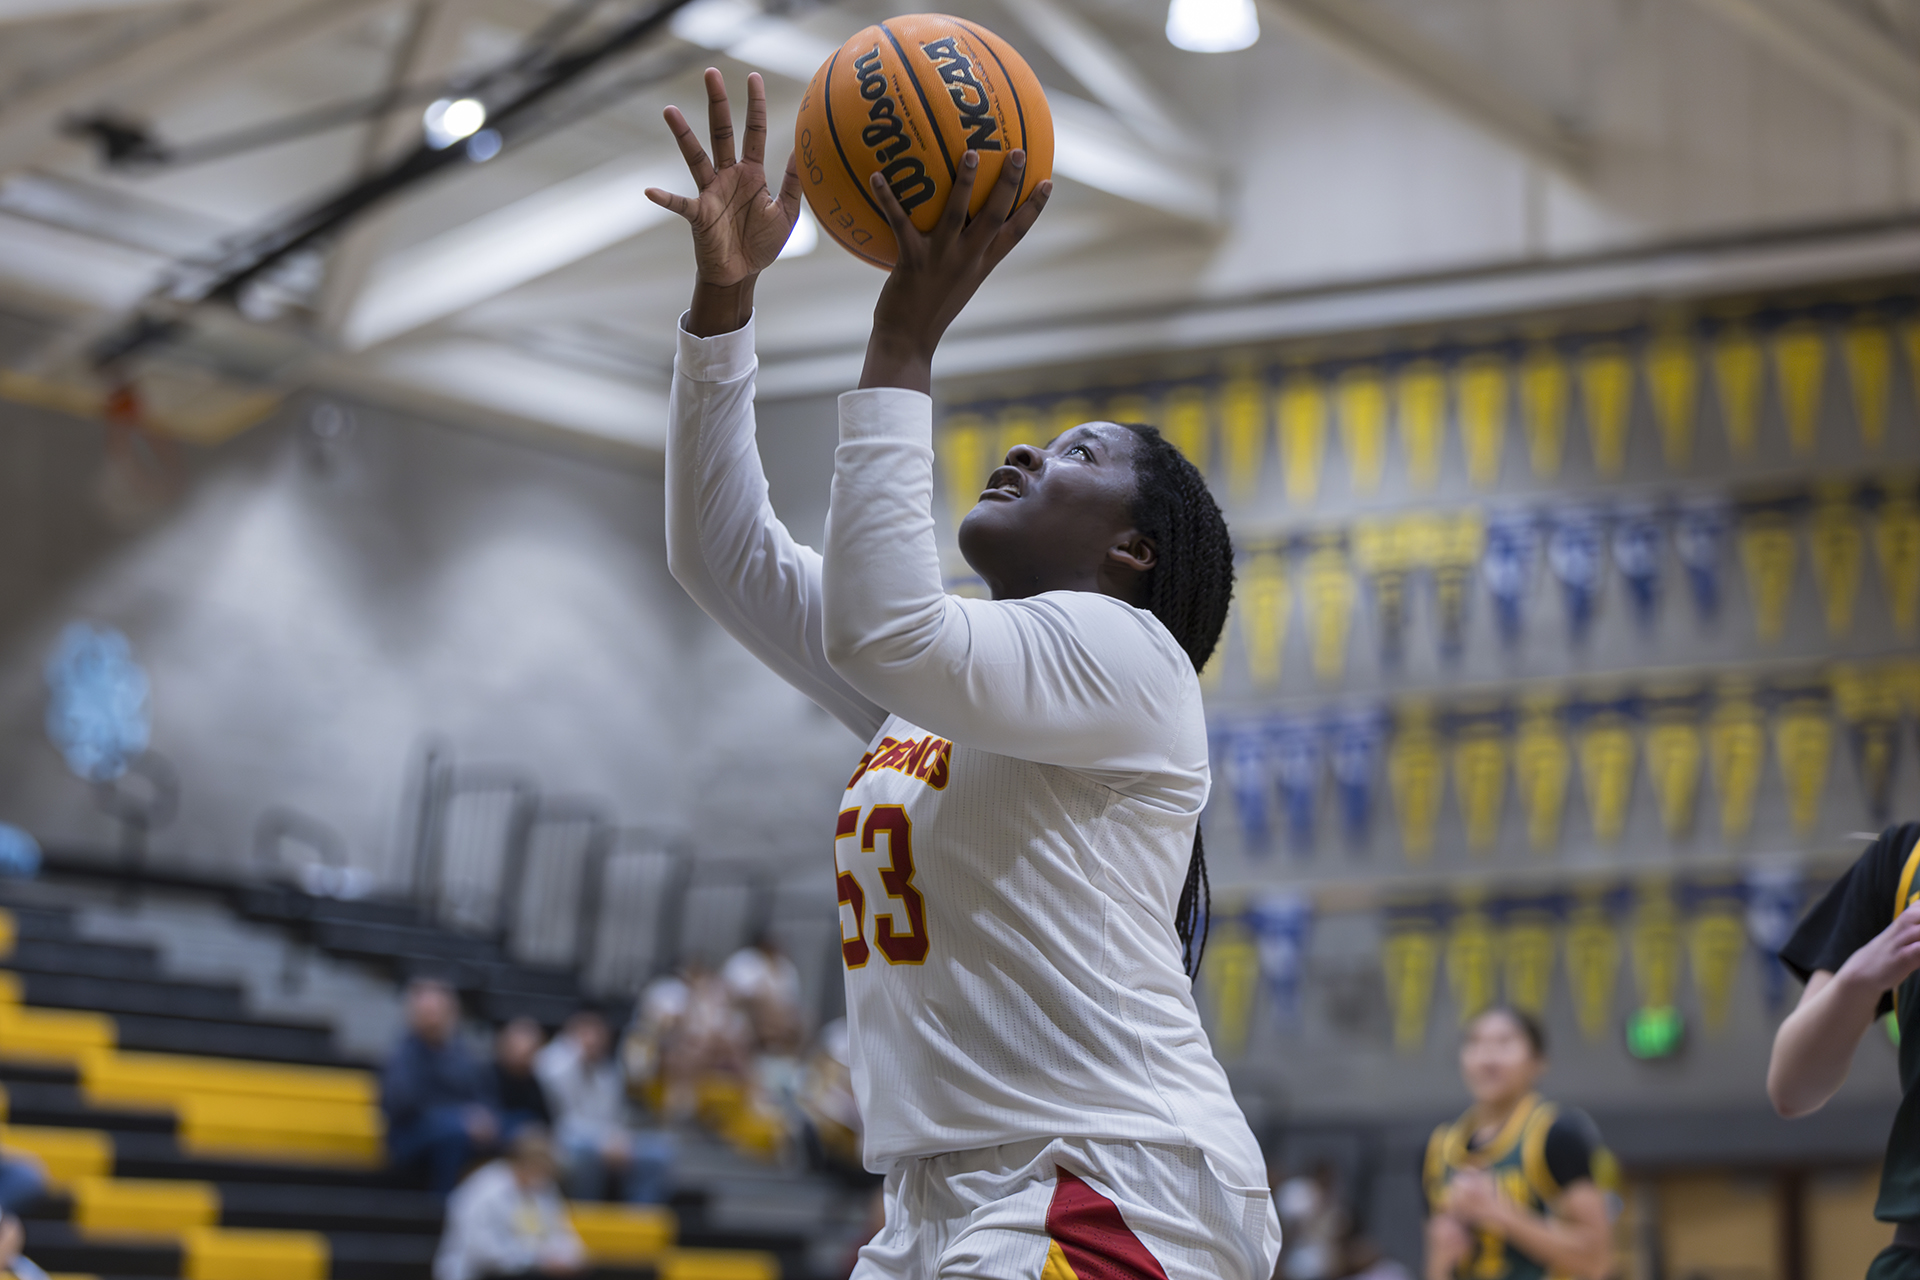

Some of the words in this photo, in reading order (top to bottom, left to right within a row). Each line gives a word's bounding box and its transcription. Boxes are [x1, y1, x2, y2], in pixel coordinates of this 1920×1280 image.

[853, 44, 937, 217] Wilson
[920, 36, 1002, 152] NCAA
[800, 128, 824, 186] ORO
[829, 196, 874, 246] DEL
[834, 803, 930, 971] 53
